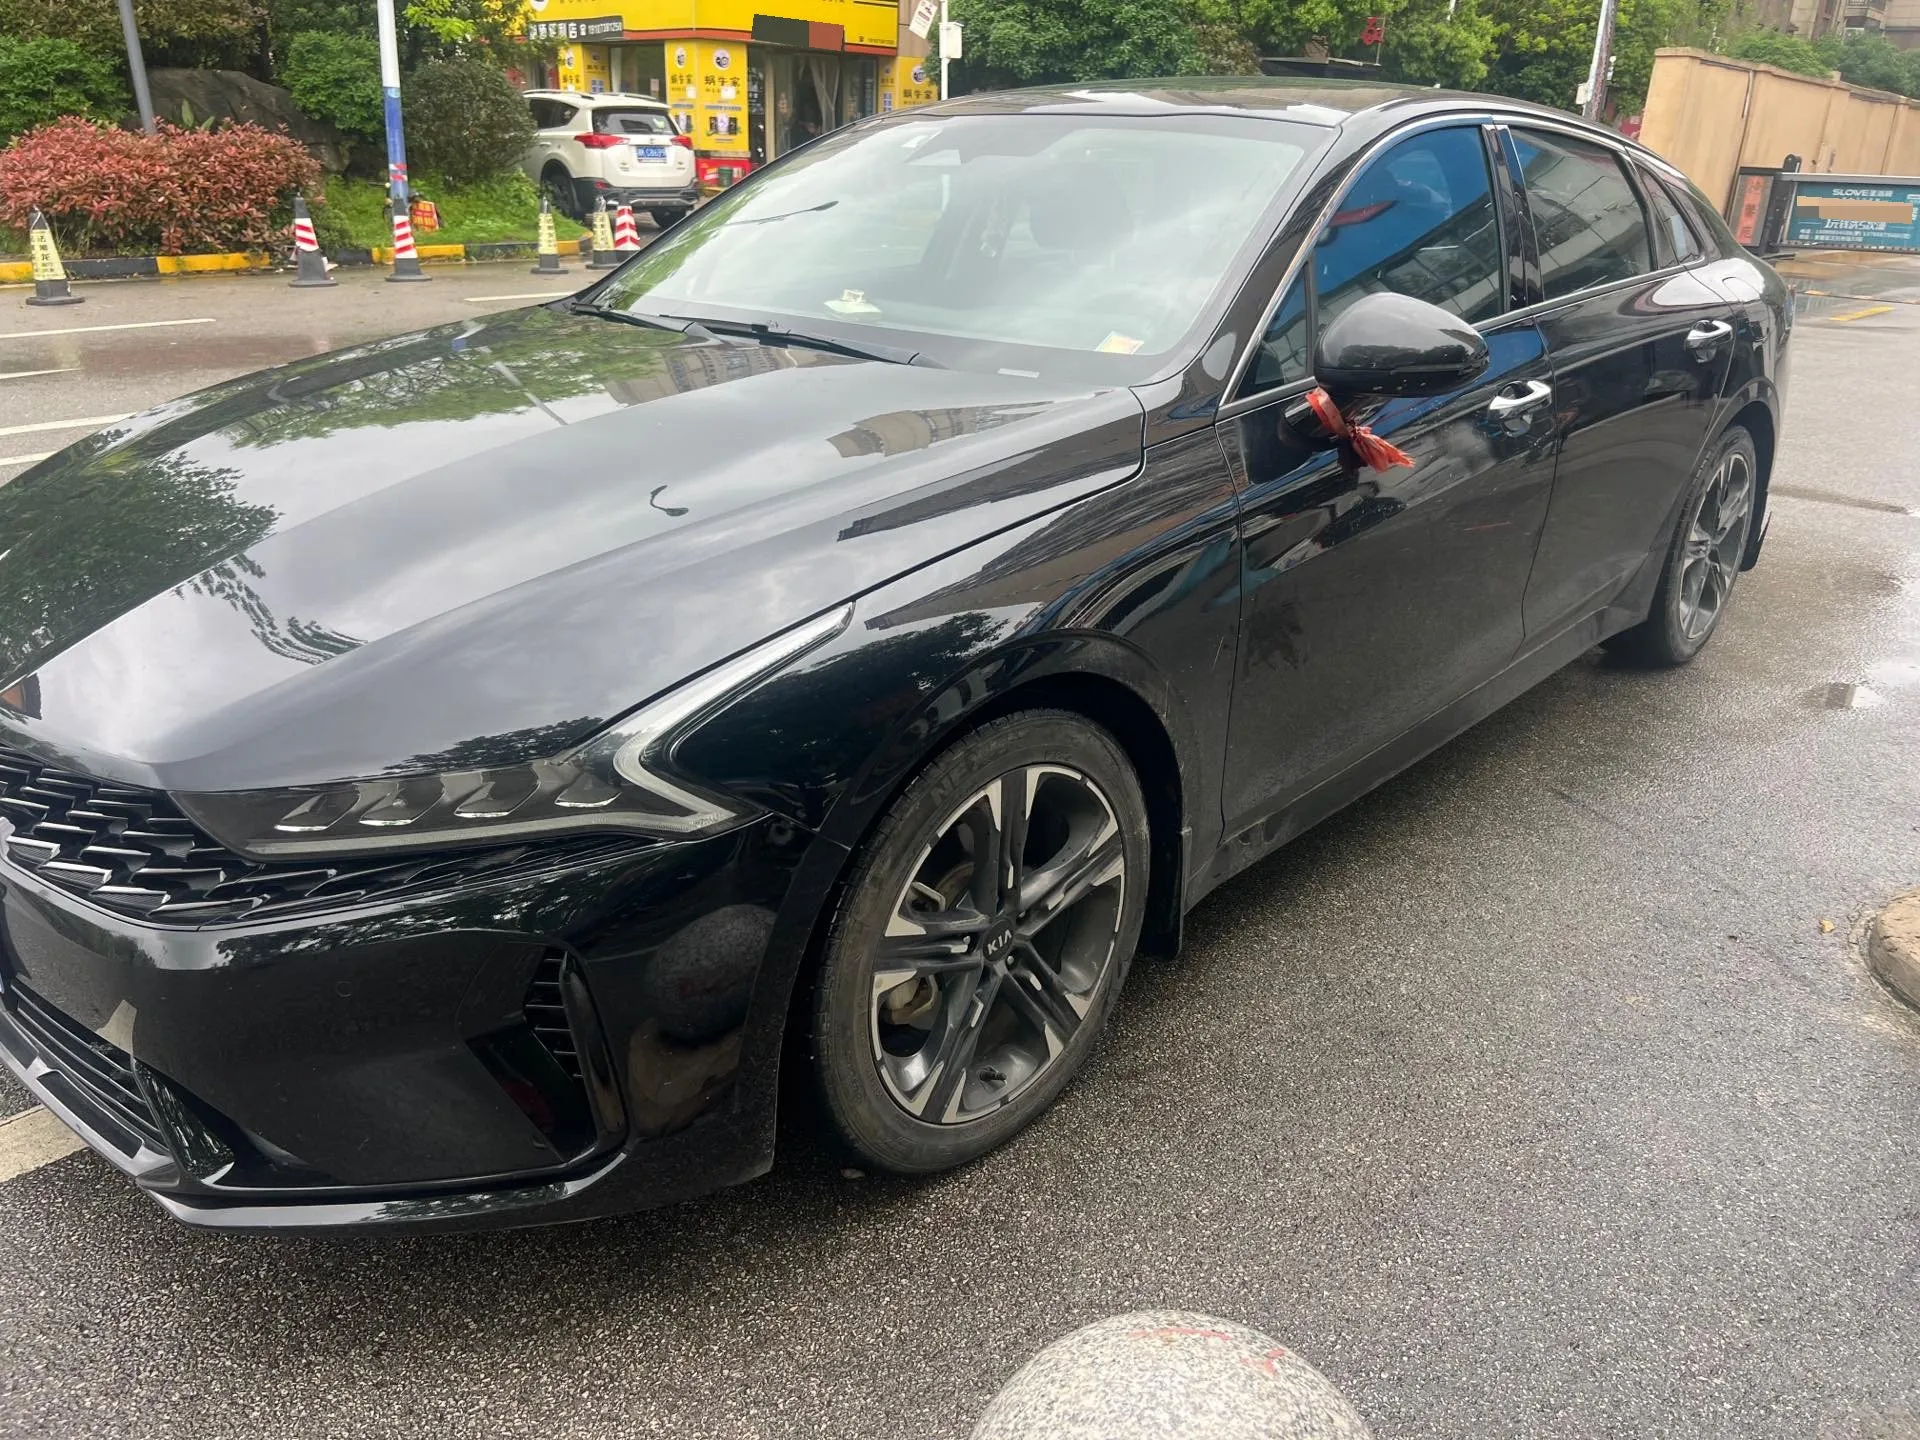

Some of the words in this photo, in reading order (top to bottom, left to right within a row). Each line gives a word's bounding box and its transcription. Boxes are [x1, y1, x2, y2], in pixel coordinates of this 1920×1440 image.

[704, 75, 741, 87] 蜗牛家
[982, 929, 1012, 955] KIA
